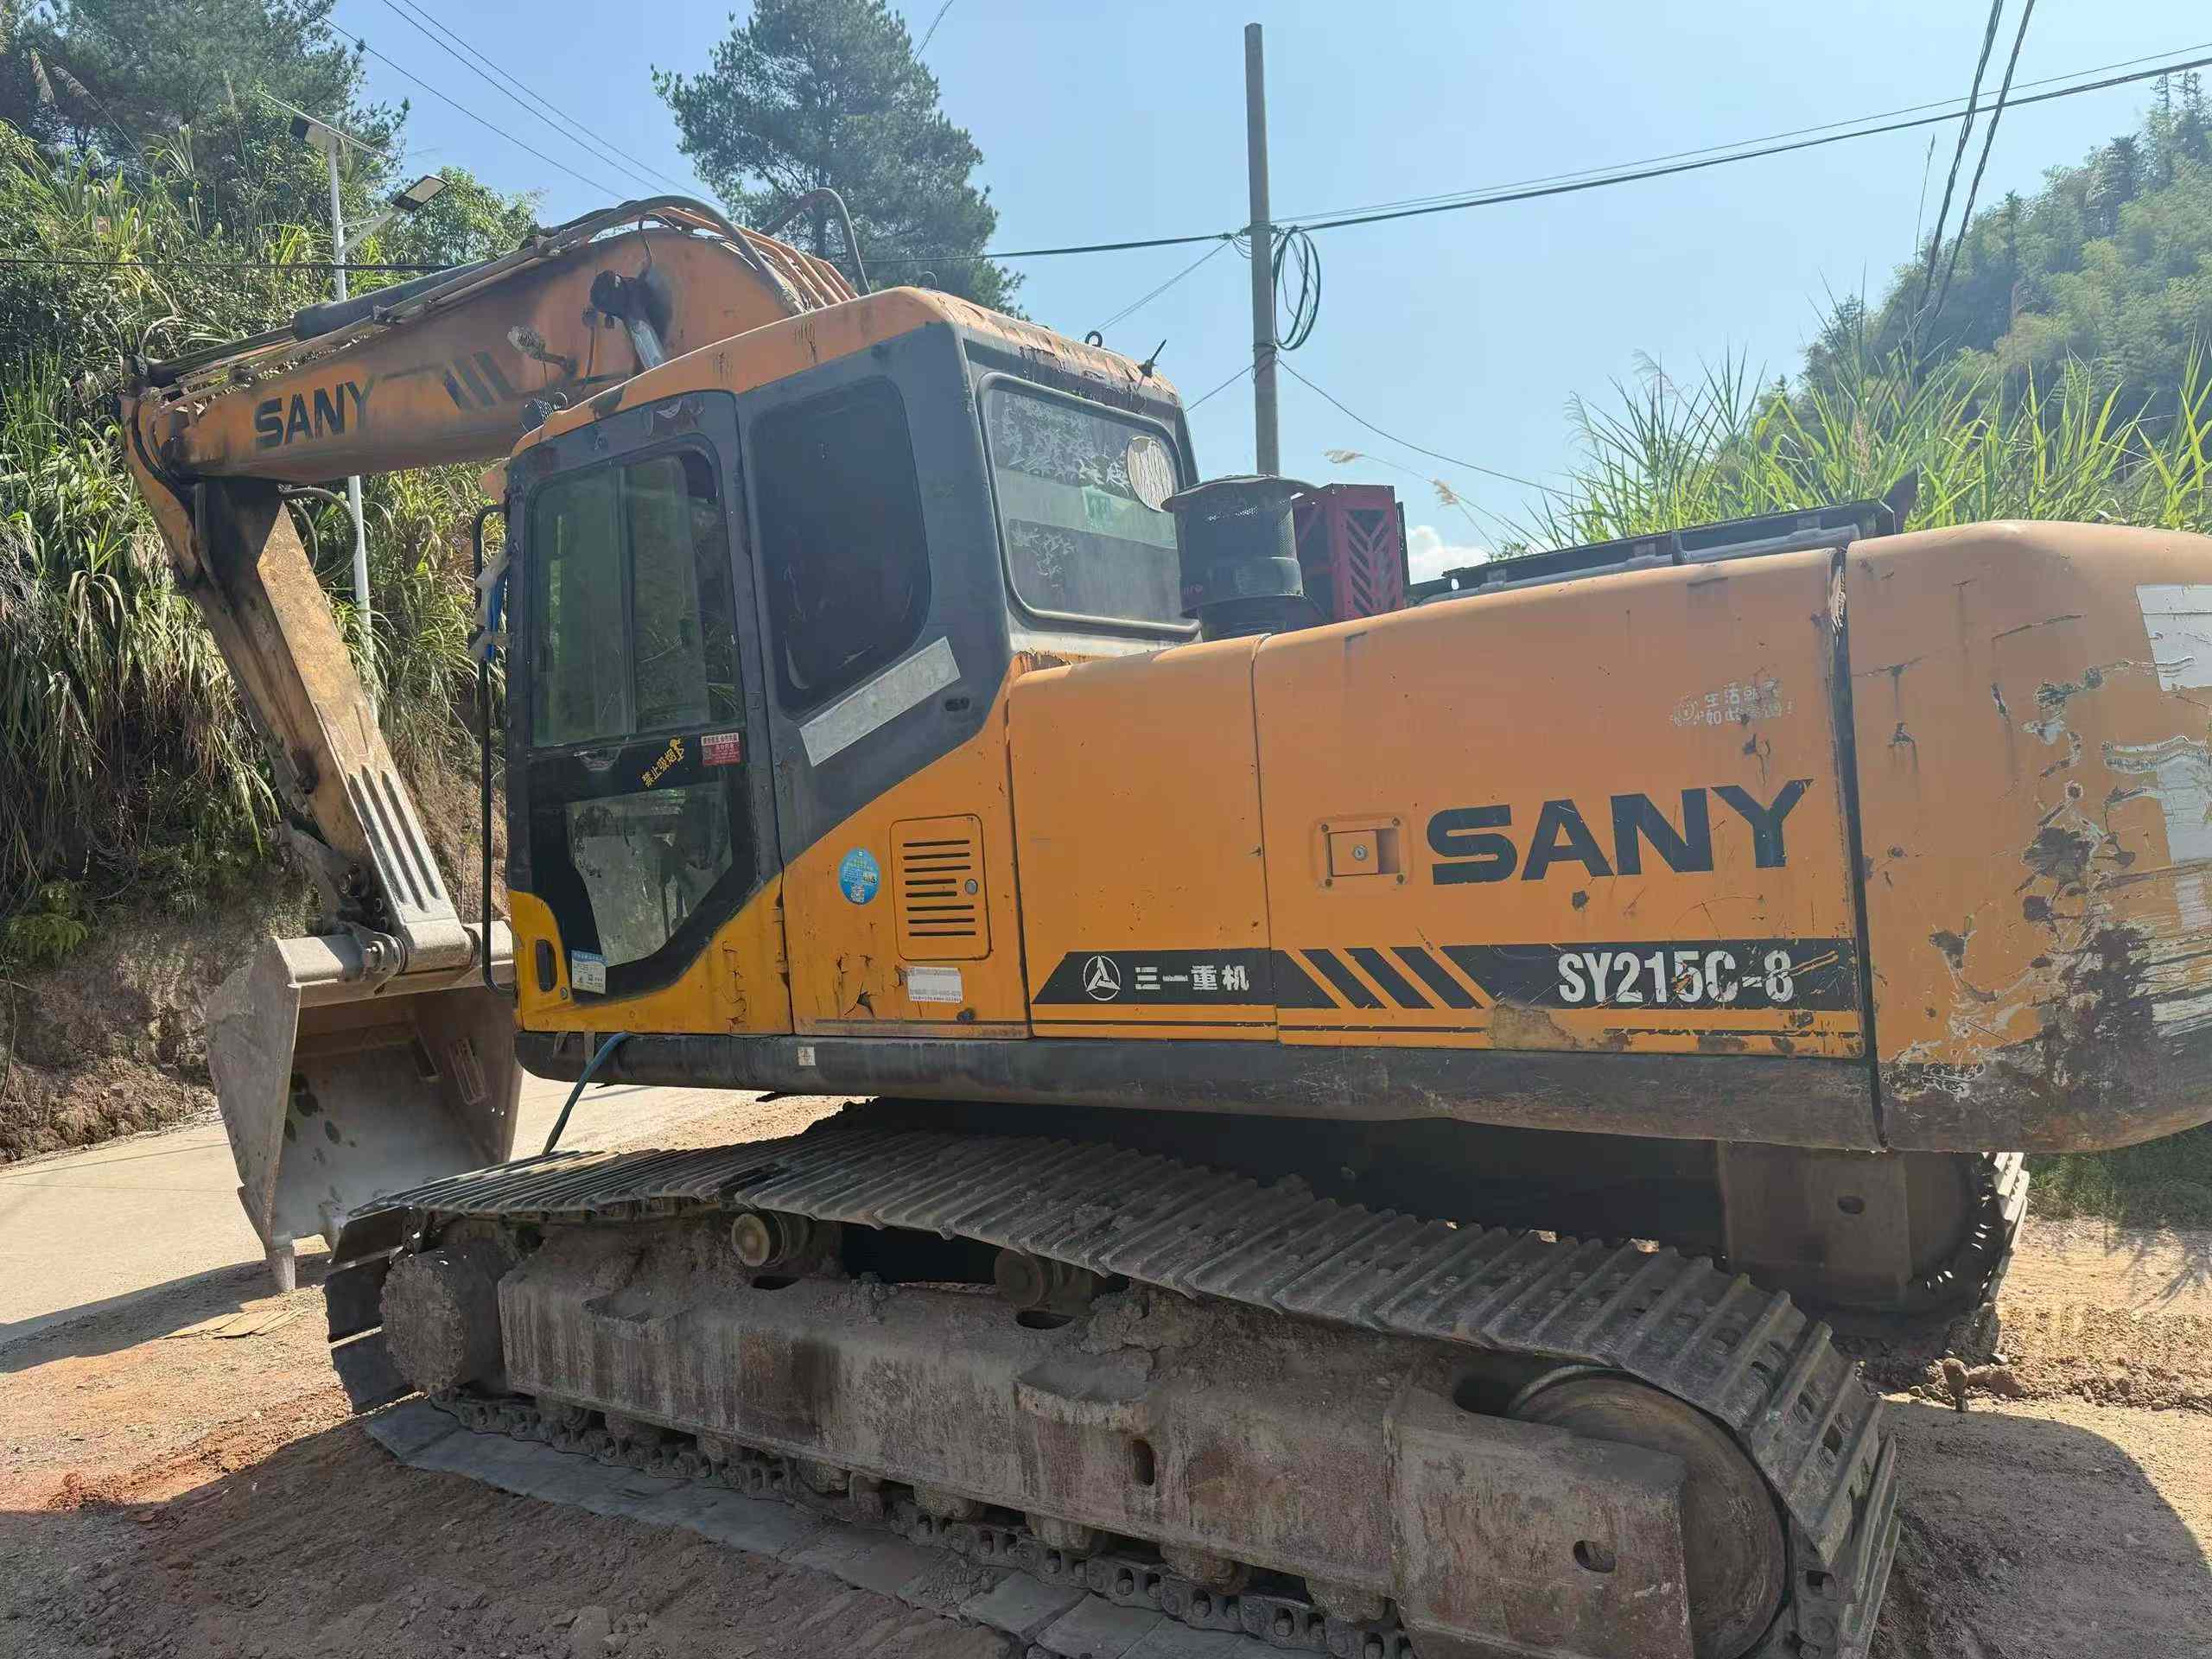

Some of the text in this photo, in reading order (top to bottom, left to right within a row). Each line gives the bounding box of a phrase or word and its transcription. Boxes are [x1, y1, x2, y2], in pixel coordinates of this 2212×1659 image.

[254, 375, 374, 448] SANY
[641, 747, 677, 788] 禁止吸烟
[1427, 779, 1814, 885] SANY
[1135, 964, 1250, 991] 三一重机
[1557, 950, 1795, 1003] SY215C-8
